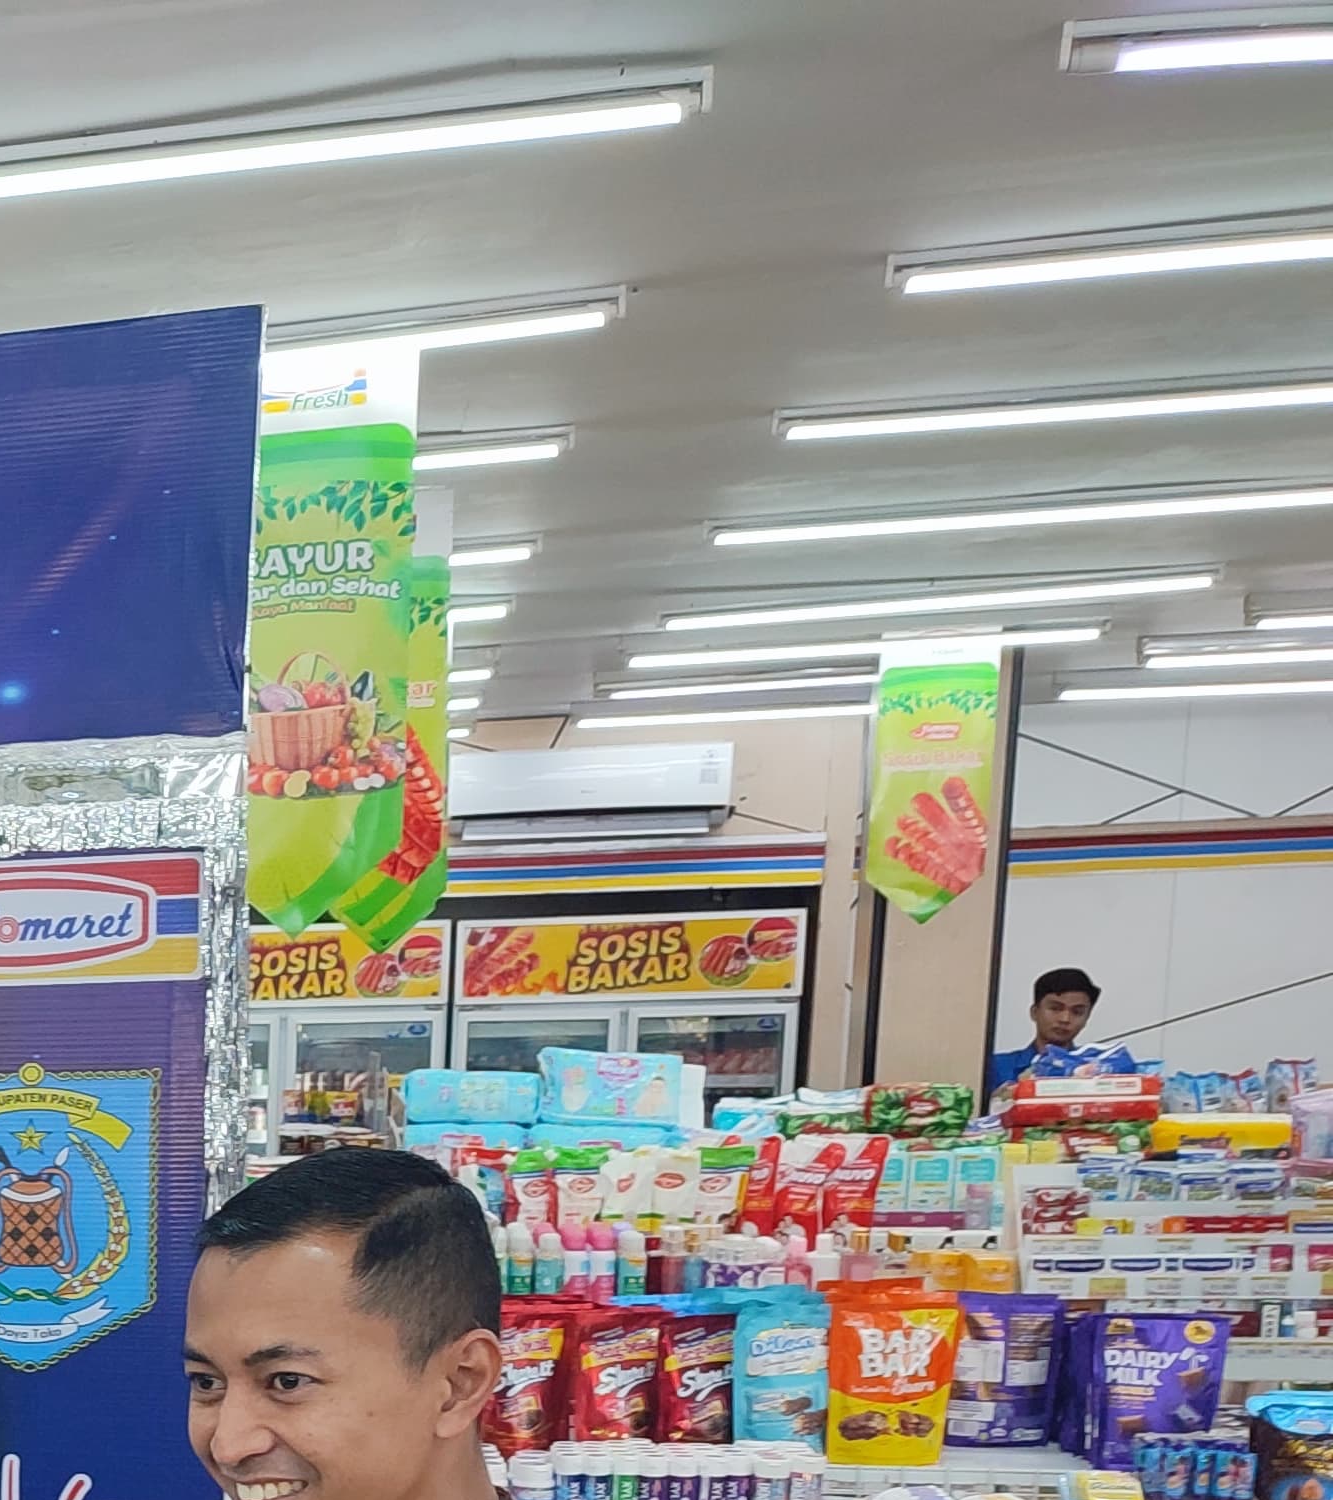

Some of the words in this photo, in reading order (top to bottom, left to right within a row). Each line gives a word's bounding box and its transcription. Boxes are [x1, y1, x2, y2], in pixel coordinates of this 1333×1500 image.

[281, 576, 329, 599] dan
[332, 574, 402, 600] Sehat
[575, 925, 684, 966] SOSIS
[566, 953, 689, 996] BAKAR
[50, 1093, 95, 1113] PASER
[857, 1327, 933, 1354] BAR
[858, 1352, 931, 1378] BAR
[1103, 1350, 1180, 1369] DAIRY
[1105, 1367, 1164, 1386] MILK
